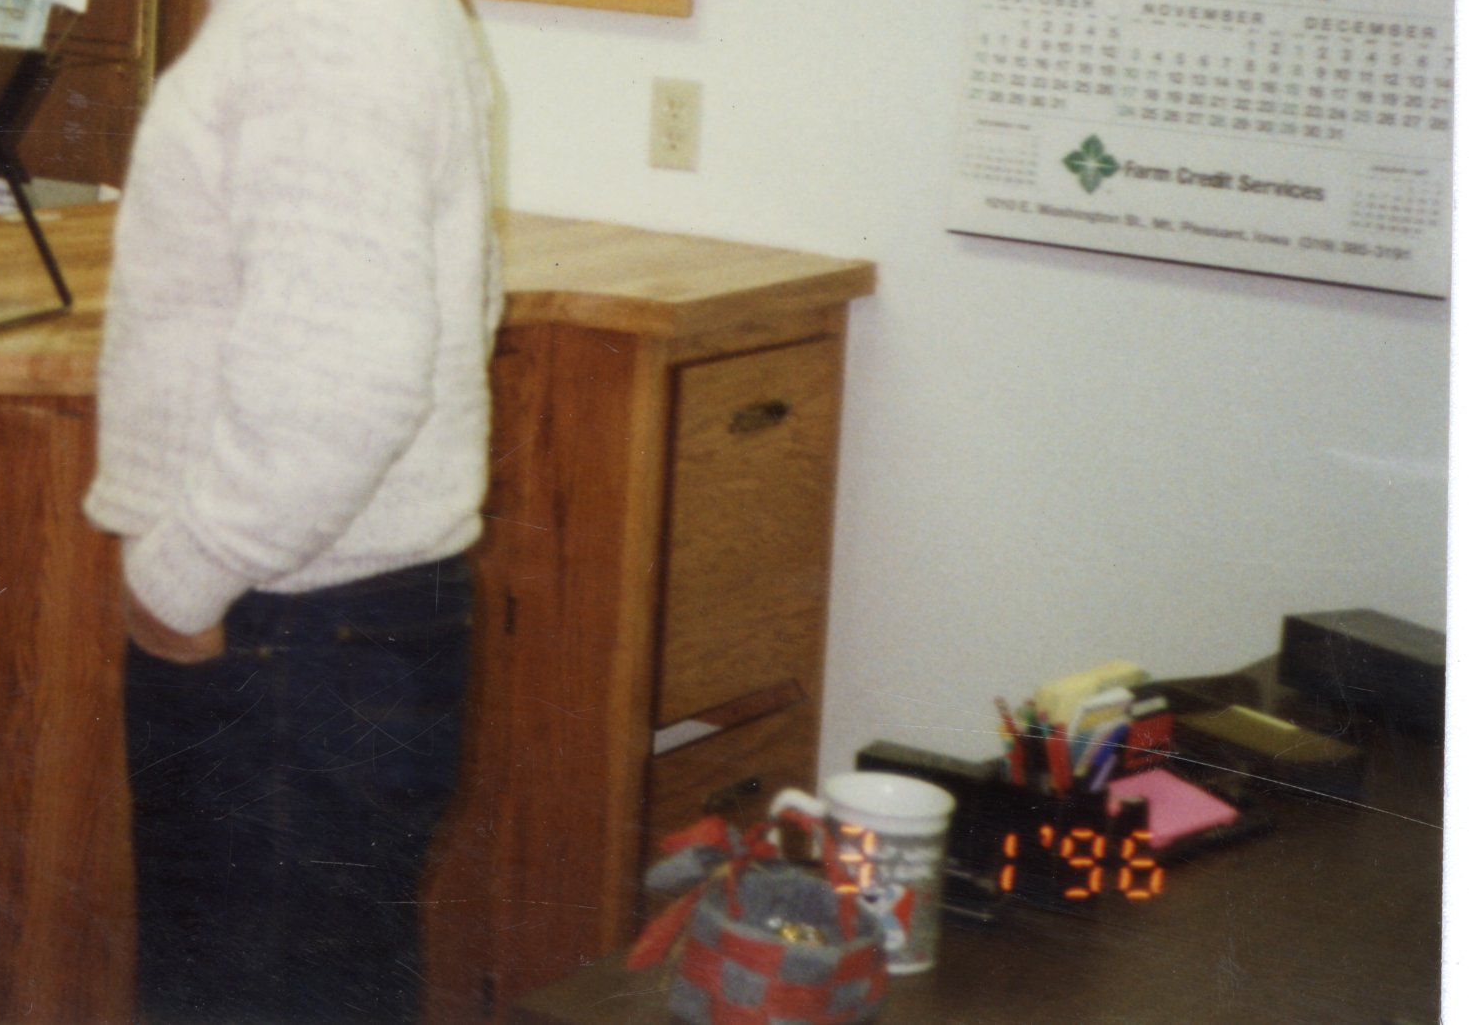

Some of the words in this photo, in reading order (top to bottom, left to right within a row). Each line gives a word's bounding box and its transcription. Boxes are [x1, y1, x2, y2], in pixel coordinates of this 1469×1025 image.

[1124, 159, 1172, 182] Farm
[1176, 166, 1235, 190] Credit
[1238, 173, 1326, 202] Services
